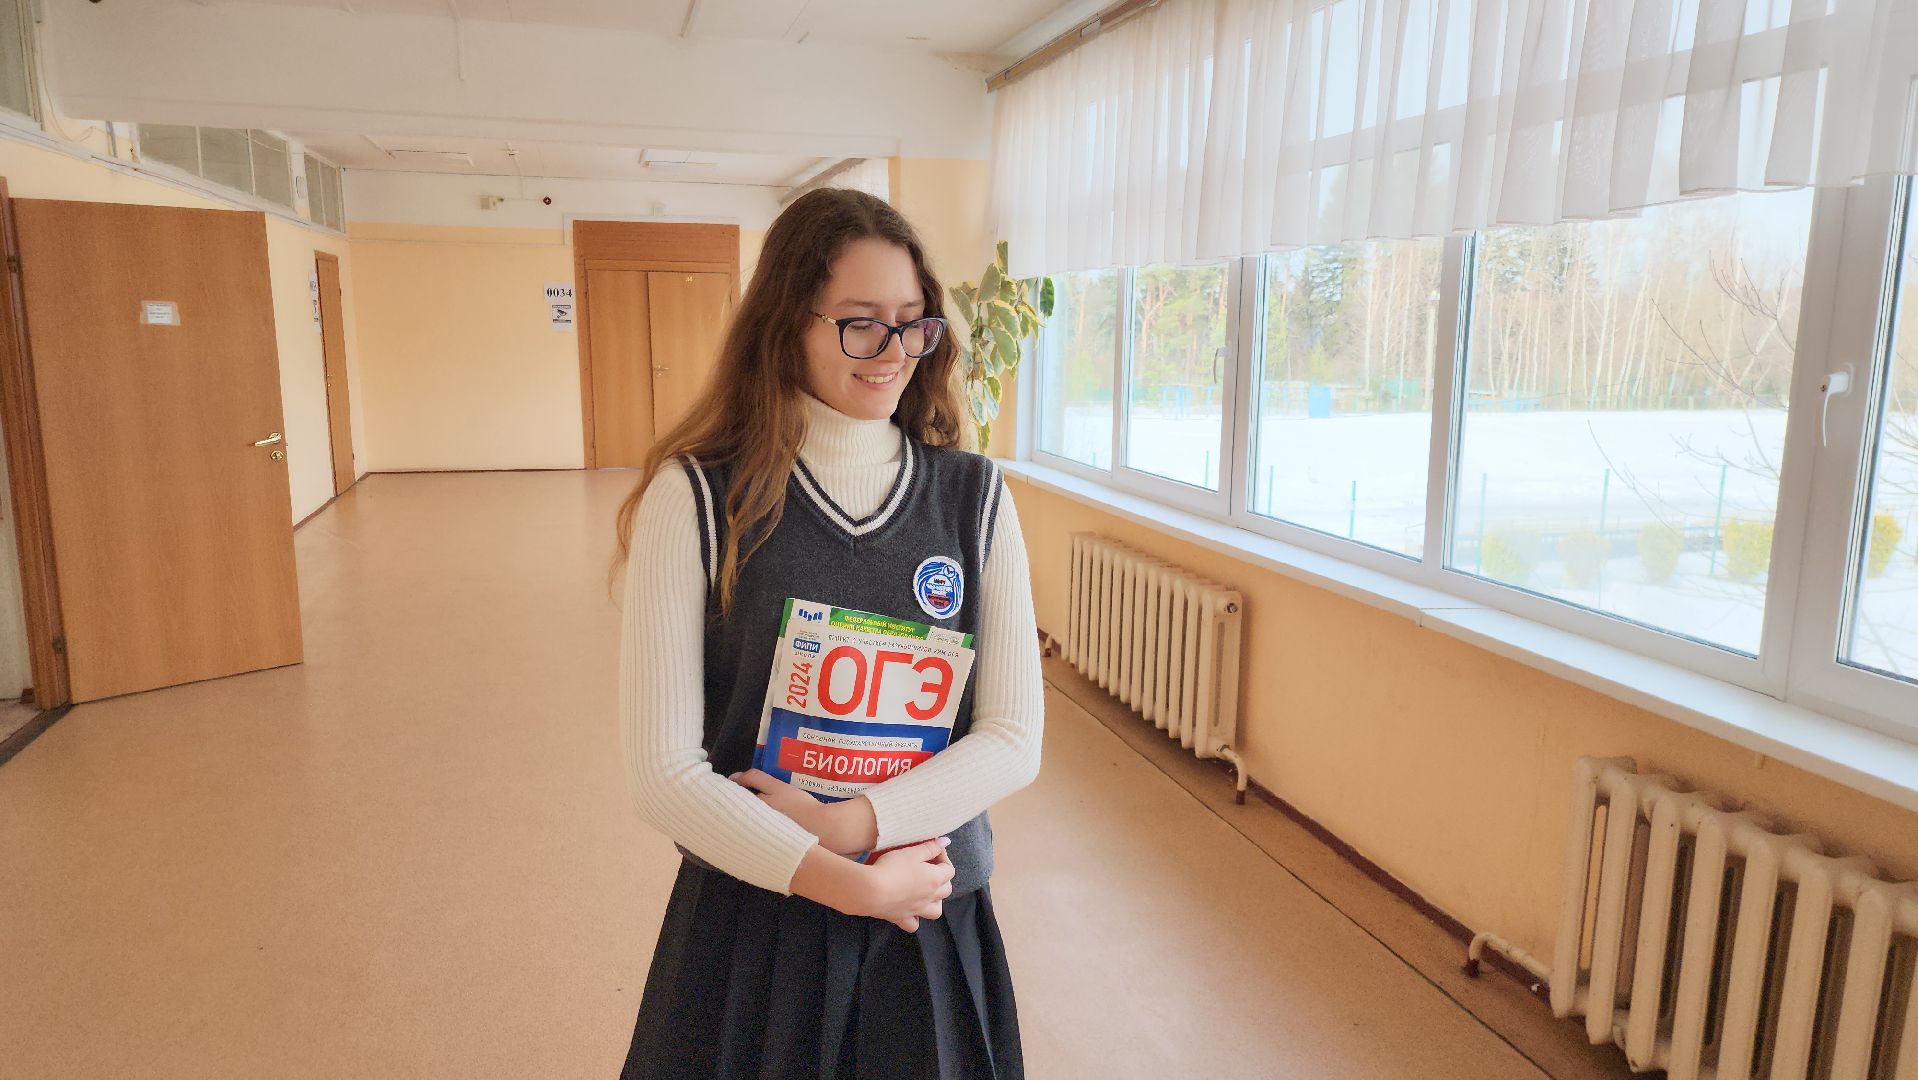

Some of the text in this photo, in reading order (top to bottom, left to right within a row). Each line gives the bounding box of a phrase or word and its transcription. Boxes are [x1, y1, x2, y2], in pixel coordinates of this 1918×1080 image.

[547, 288, 572, 297] 0034
[844, 615, 915, 633] ФЕДЕРАЛЬНЫЙ ИНСТИТУТ
[796, 641, 819, 652] ФИПИ
[787, 662, 812, 709] 2024
[817, 645, 953, 721] ОГЭ
[803, 750, 912, 776] БИОЛОГИЯ
